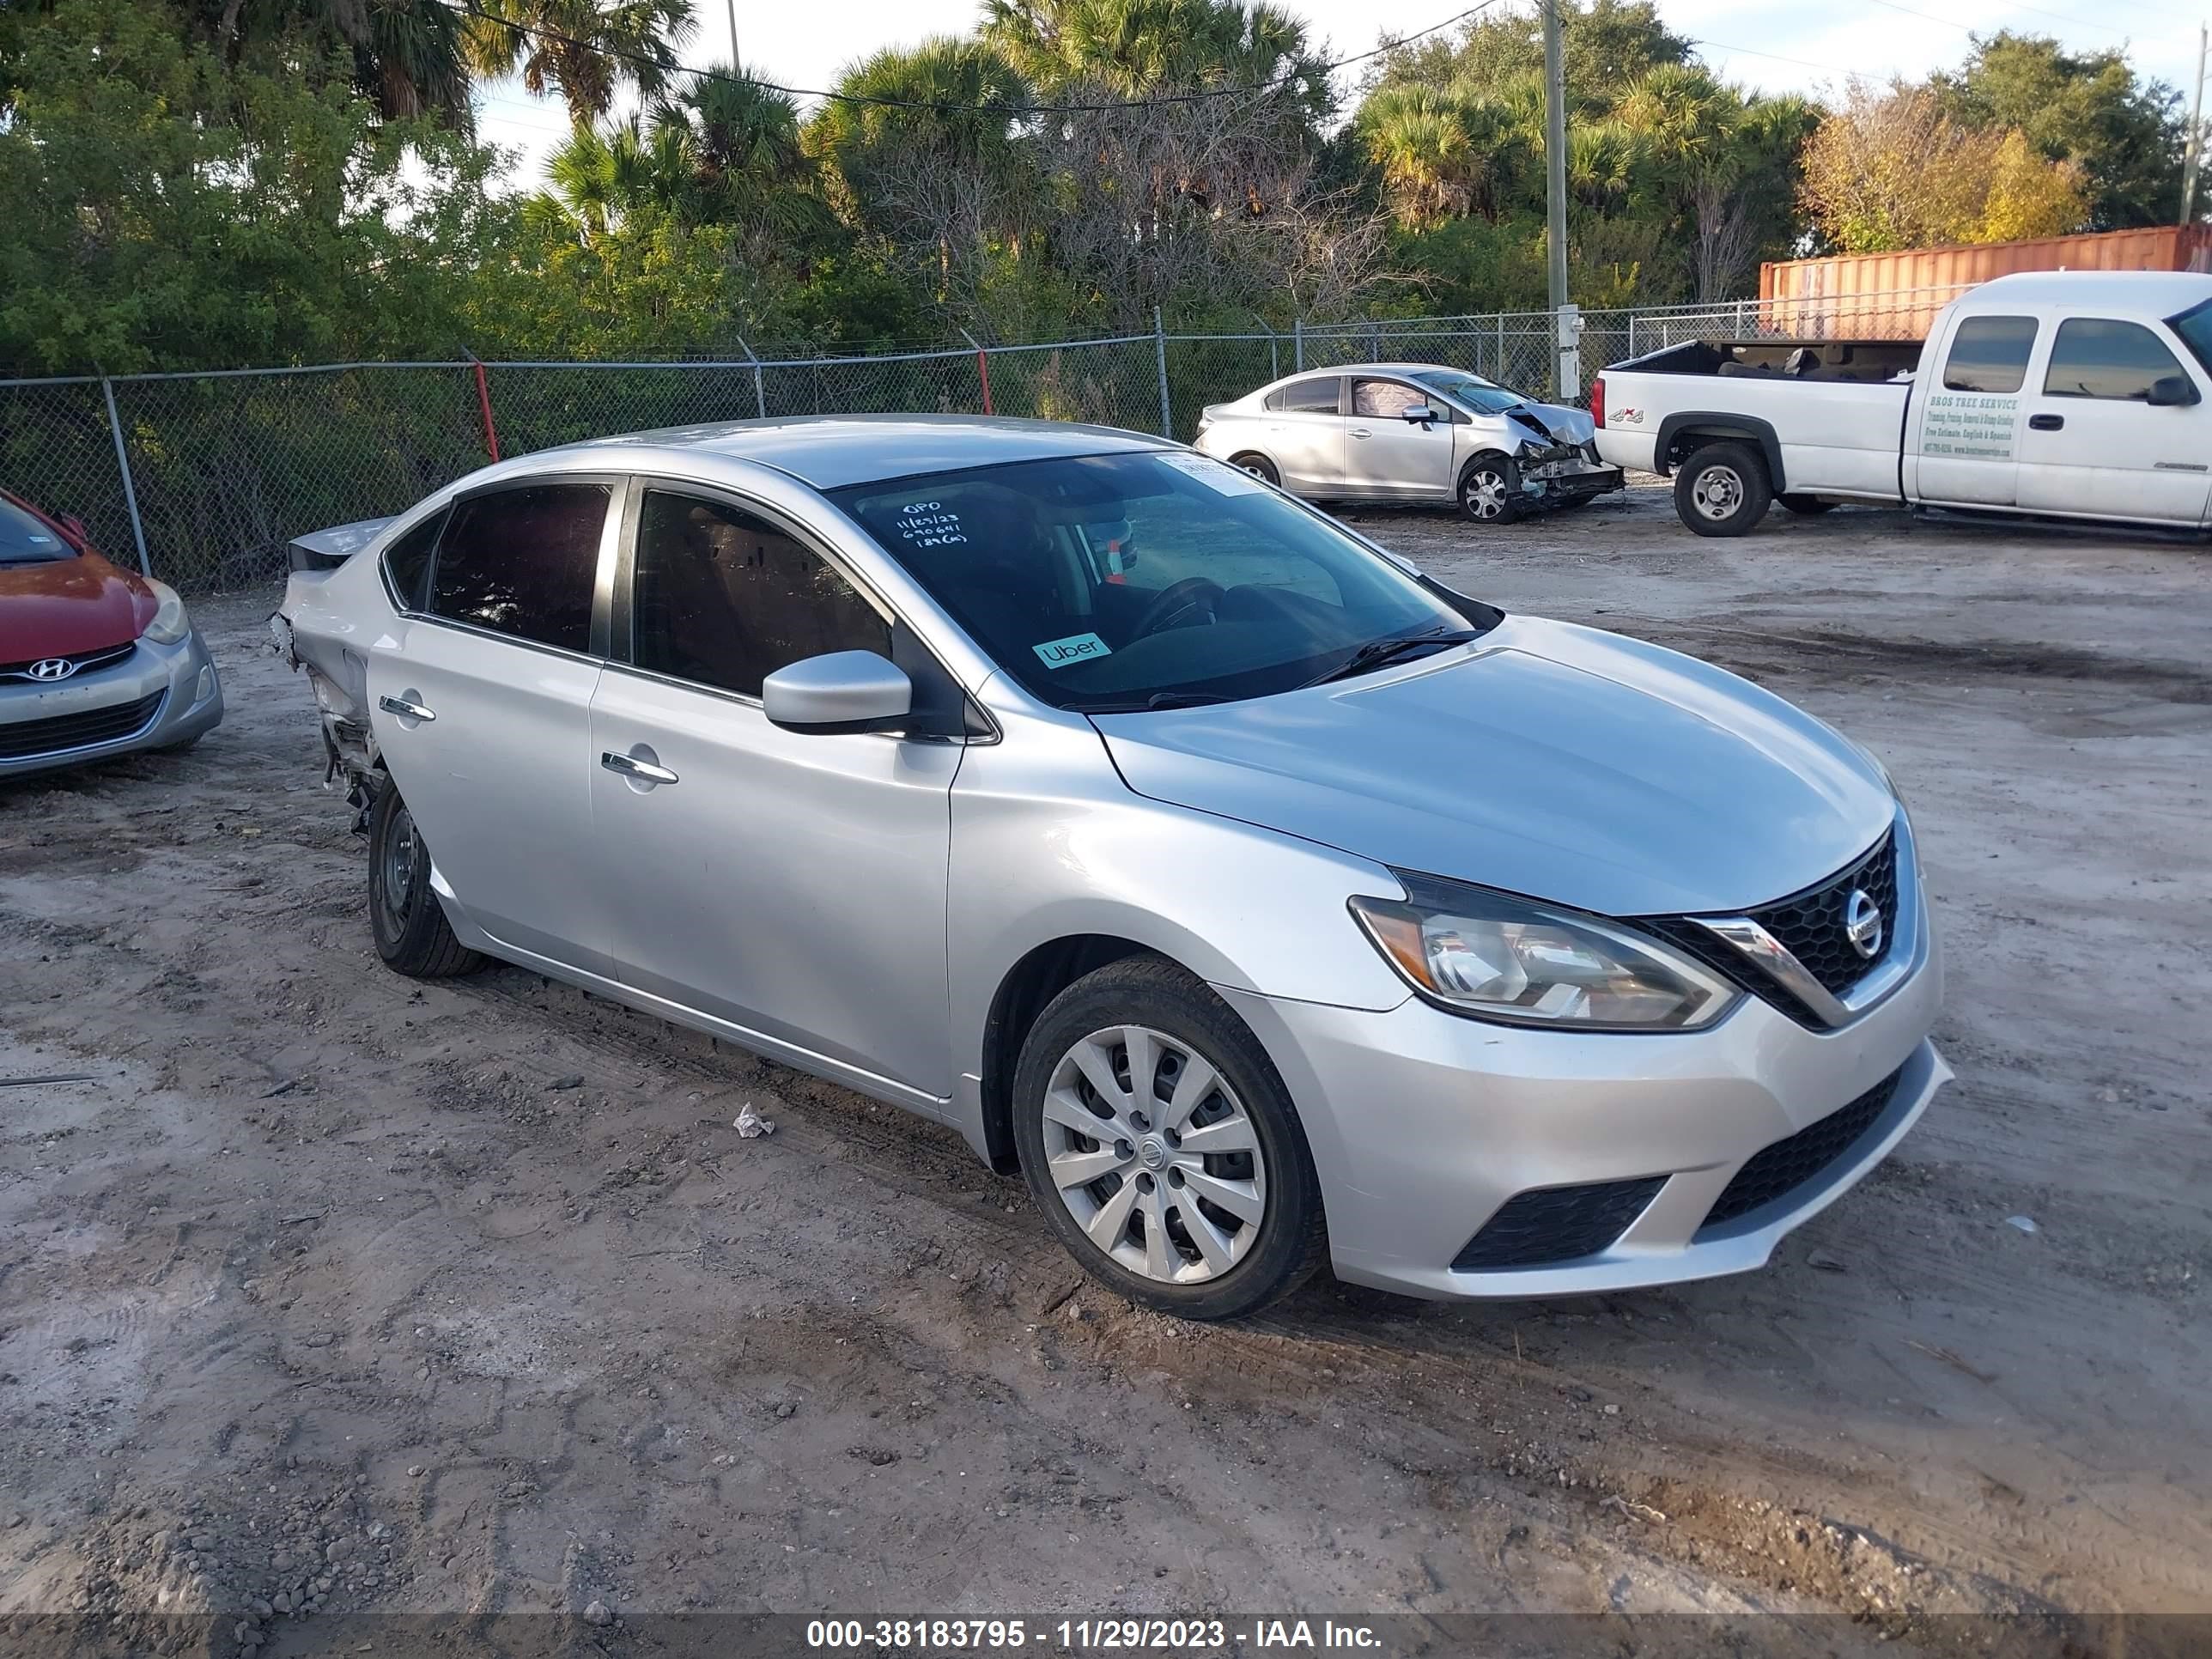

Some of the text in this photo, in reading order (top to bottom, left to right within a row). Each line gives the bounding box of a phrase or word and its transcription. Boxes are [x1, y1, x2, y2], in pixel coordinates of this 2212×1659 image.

[1930, 397, 2018, 410] BROS TREE SERVICE
[1042, 641, 1098, 661] Uber
